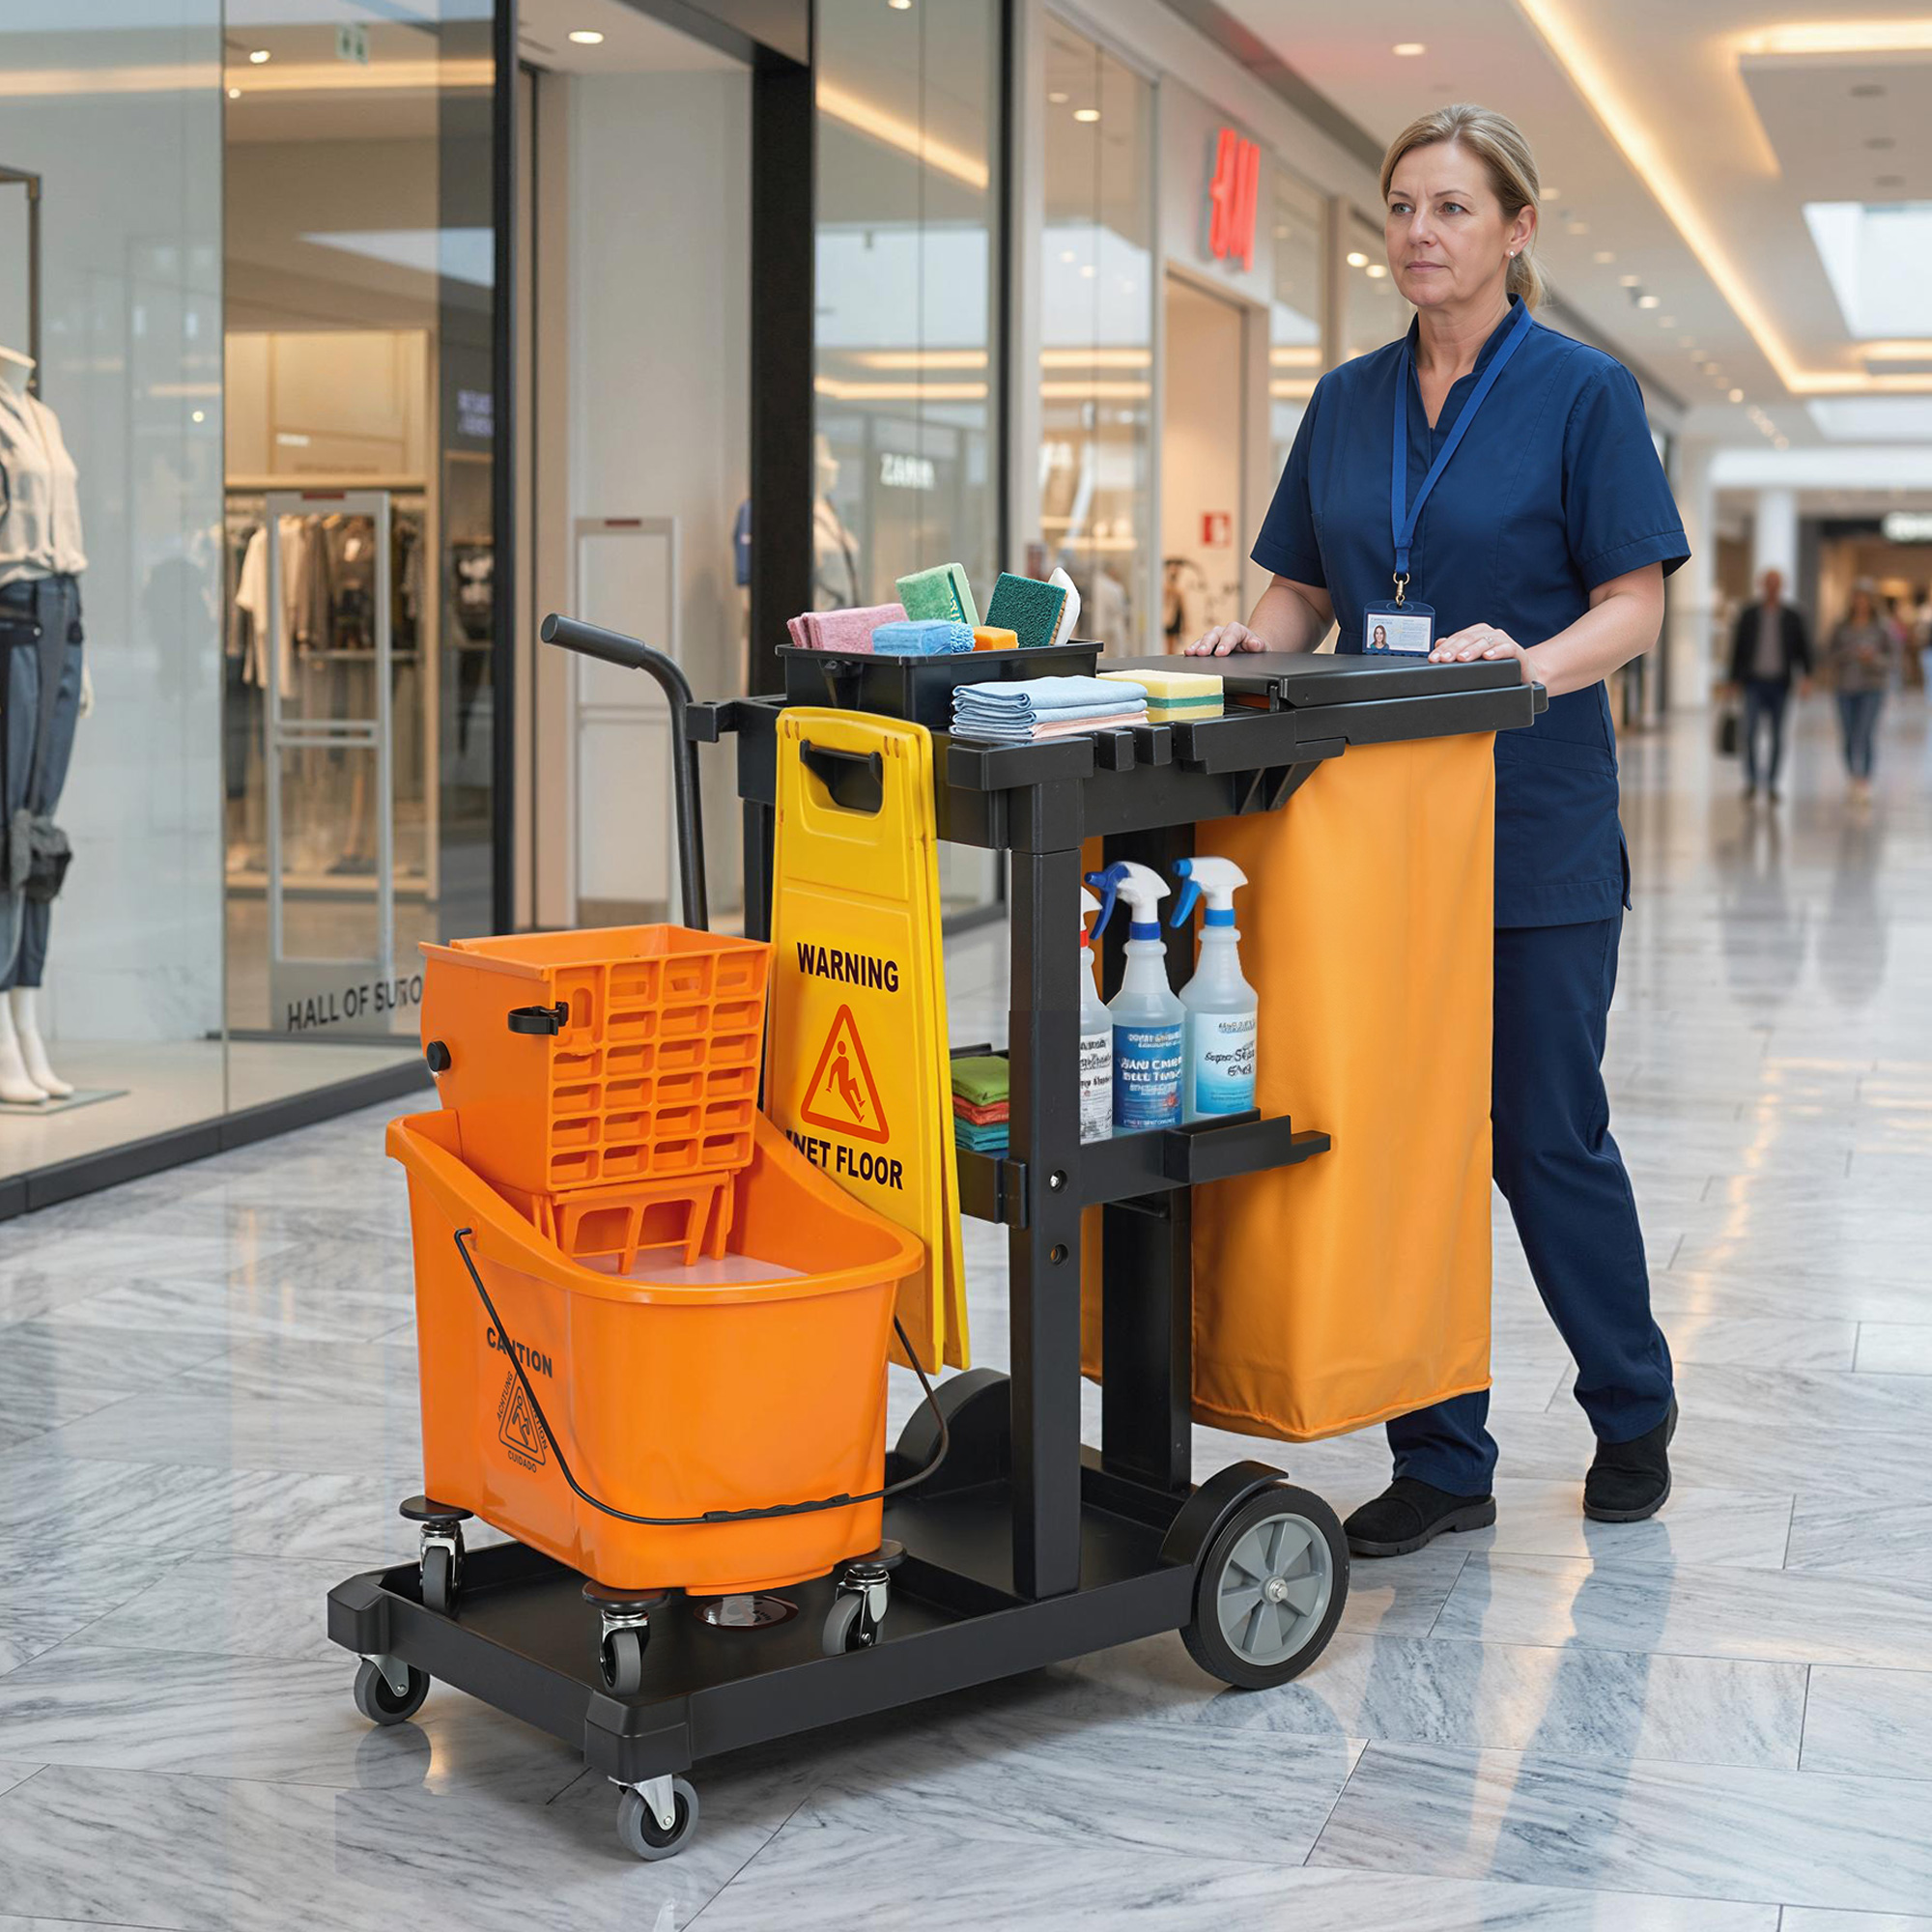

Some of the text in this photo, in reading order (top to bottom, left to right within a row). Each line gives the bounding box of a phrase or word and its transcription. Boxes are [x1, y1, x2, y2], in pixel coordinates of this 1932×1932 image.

[797, 942, 899, 992] WARNING
[288, 992, 339, 1032] HALL
[344, 984, 369, 1018] OF
[836, 1144, 903, 1190] FLOOR
[497, 1371, 513, 1423] ACHTUNG
[507, 1450, 537, 1473] CUIDADO
